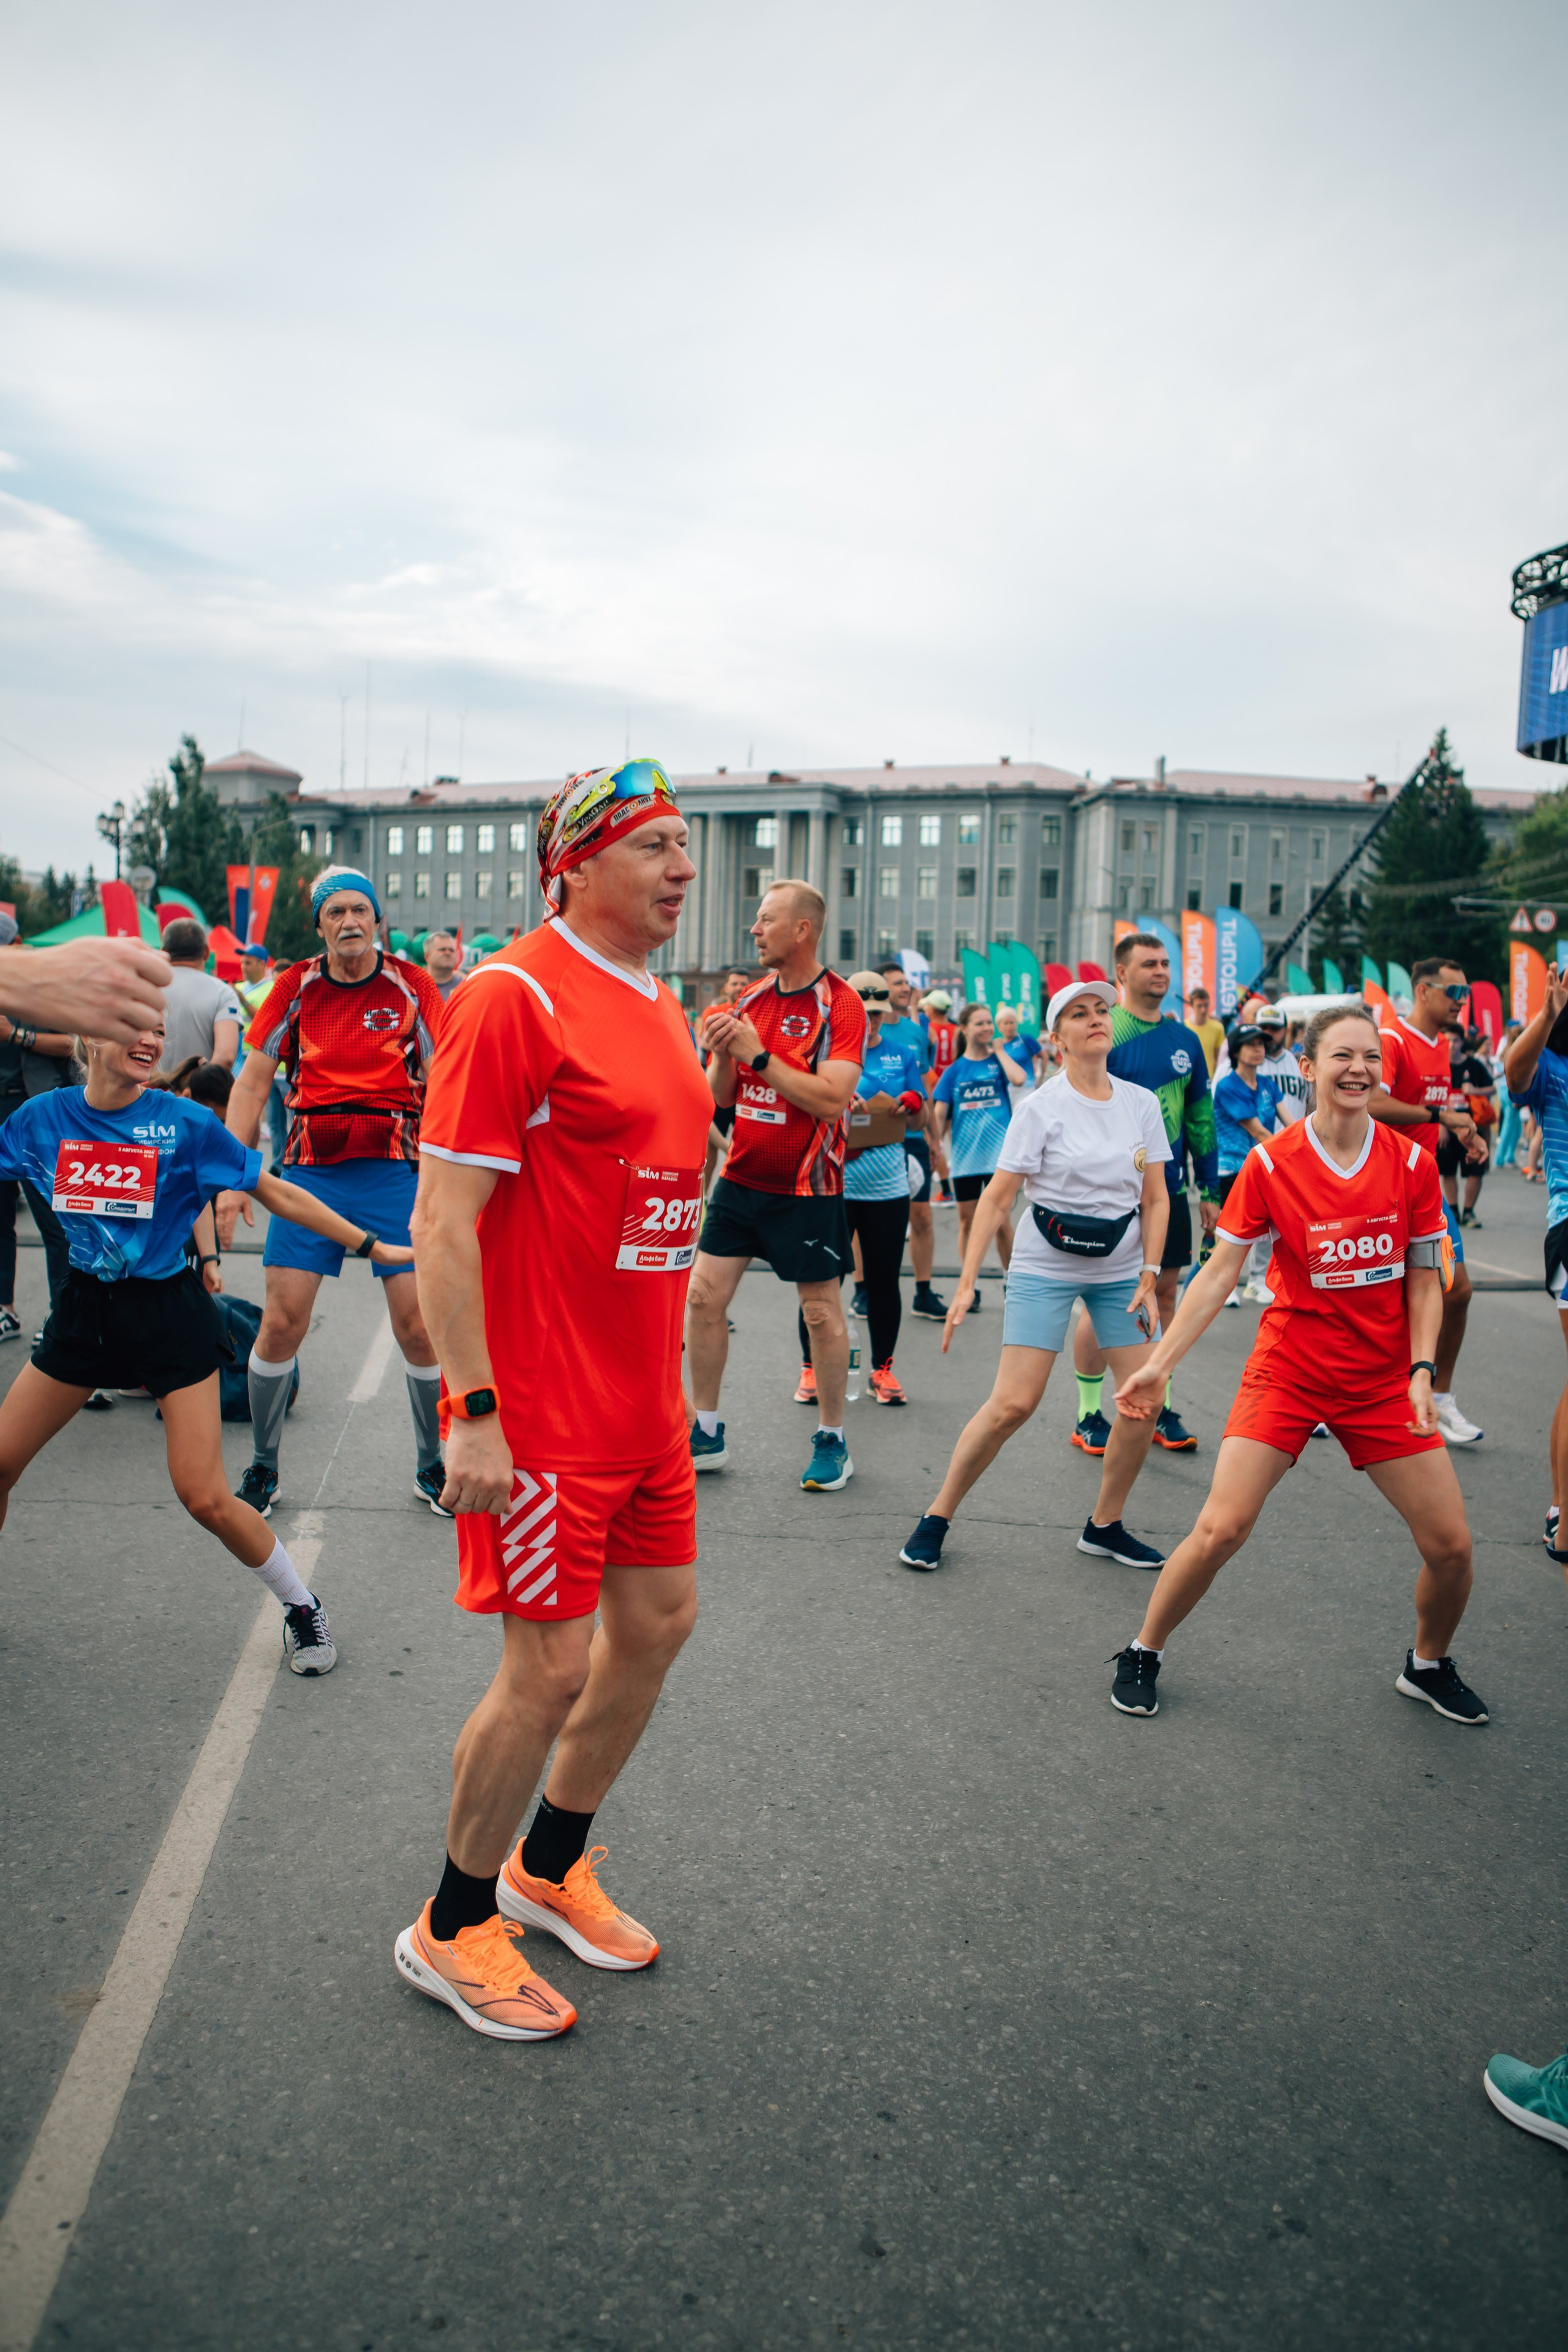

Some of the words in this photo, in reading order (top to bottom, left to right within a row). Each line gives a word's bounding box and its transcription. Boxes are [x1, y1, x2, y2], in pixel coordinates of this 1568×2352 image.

[742, 1083, 776, 1104] 1428
[963, 1085, 995, 1099] 4473
[68, 1161, 141, 1190] 2422
[642, 1197, 702, 1232] 2873
[1061, 1235, 1106, 1249] Champion
[1318, 1233, 1393, 1263] 2080
